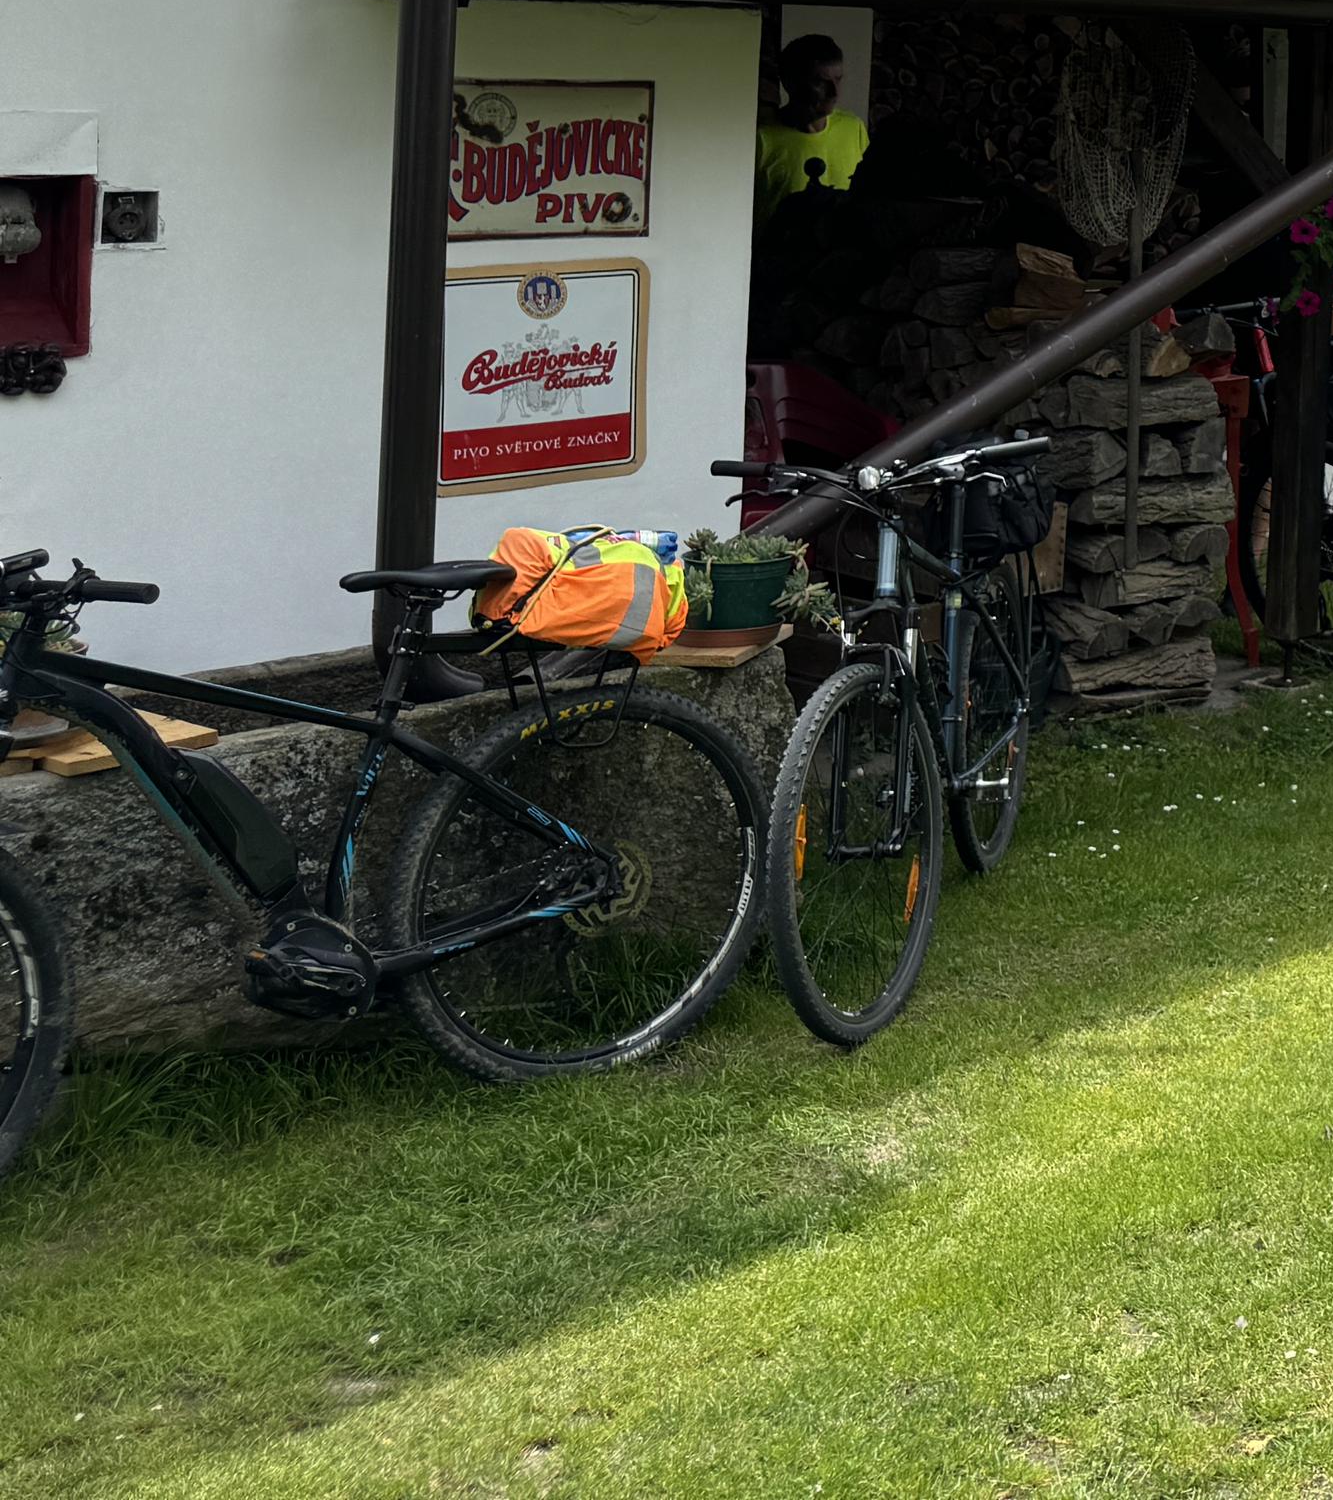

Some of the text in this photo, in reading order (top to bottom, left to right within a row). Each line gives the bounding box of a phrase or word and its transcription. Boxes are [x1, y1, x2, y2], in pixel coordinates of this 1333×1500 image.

[462, 341, 618, 392] Budějovický
[453, 431, 621, 460] PIVO SVĚTOVÉ ZNAČKY
